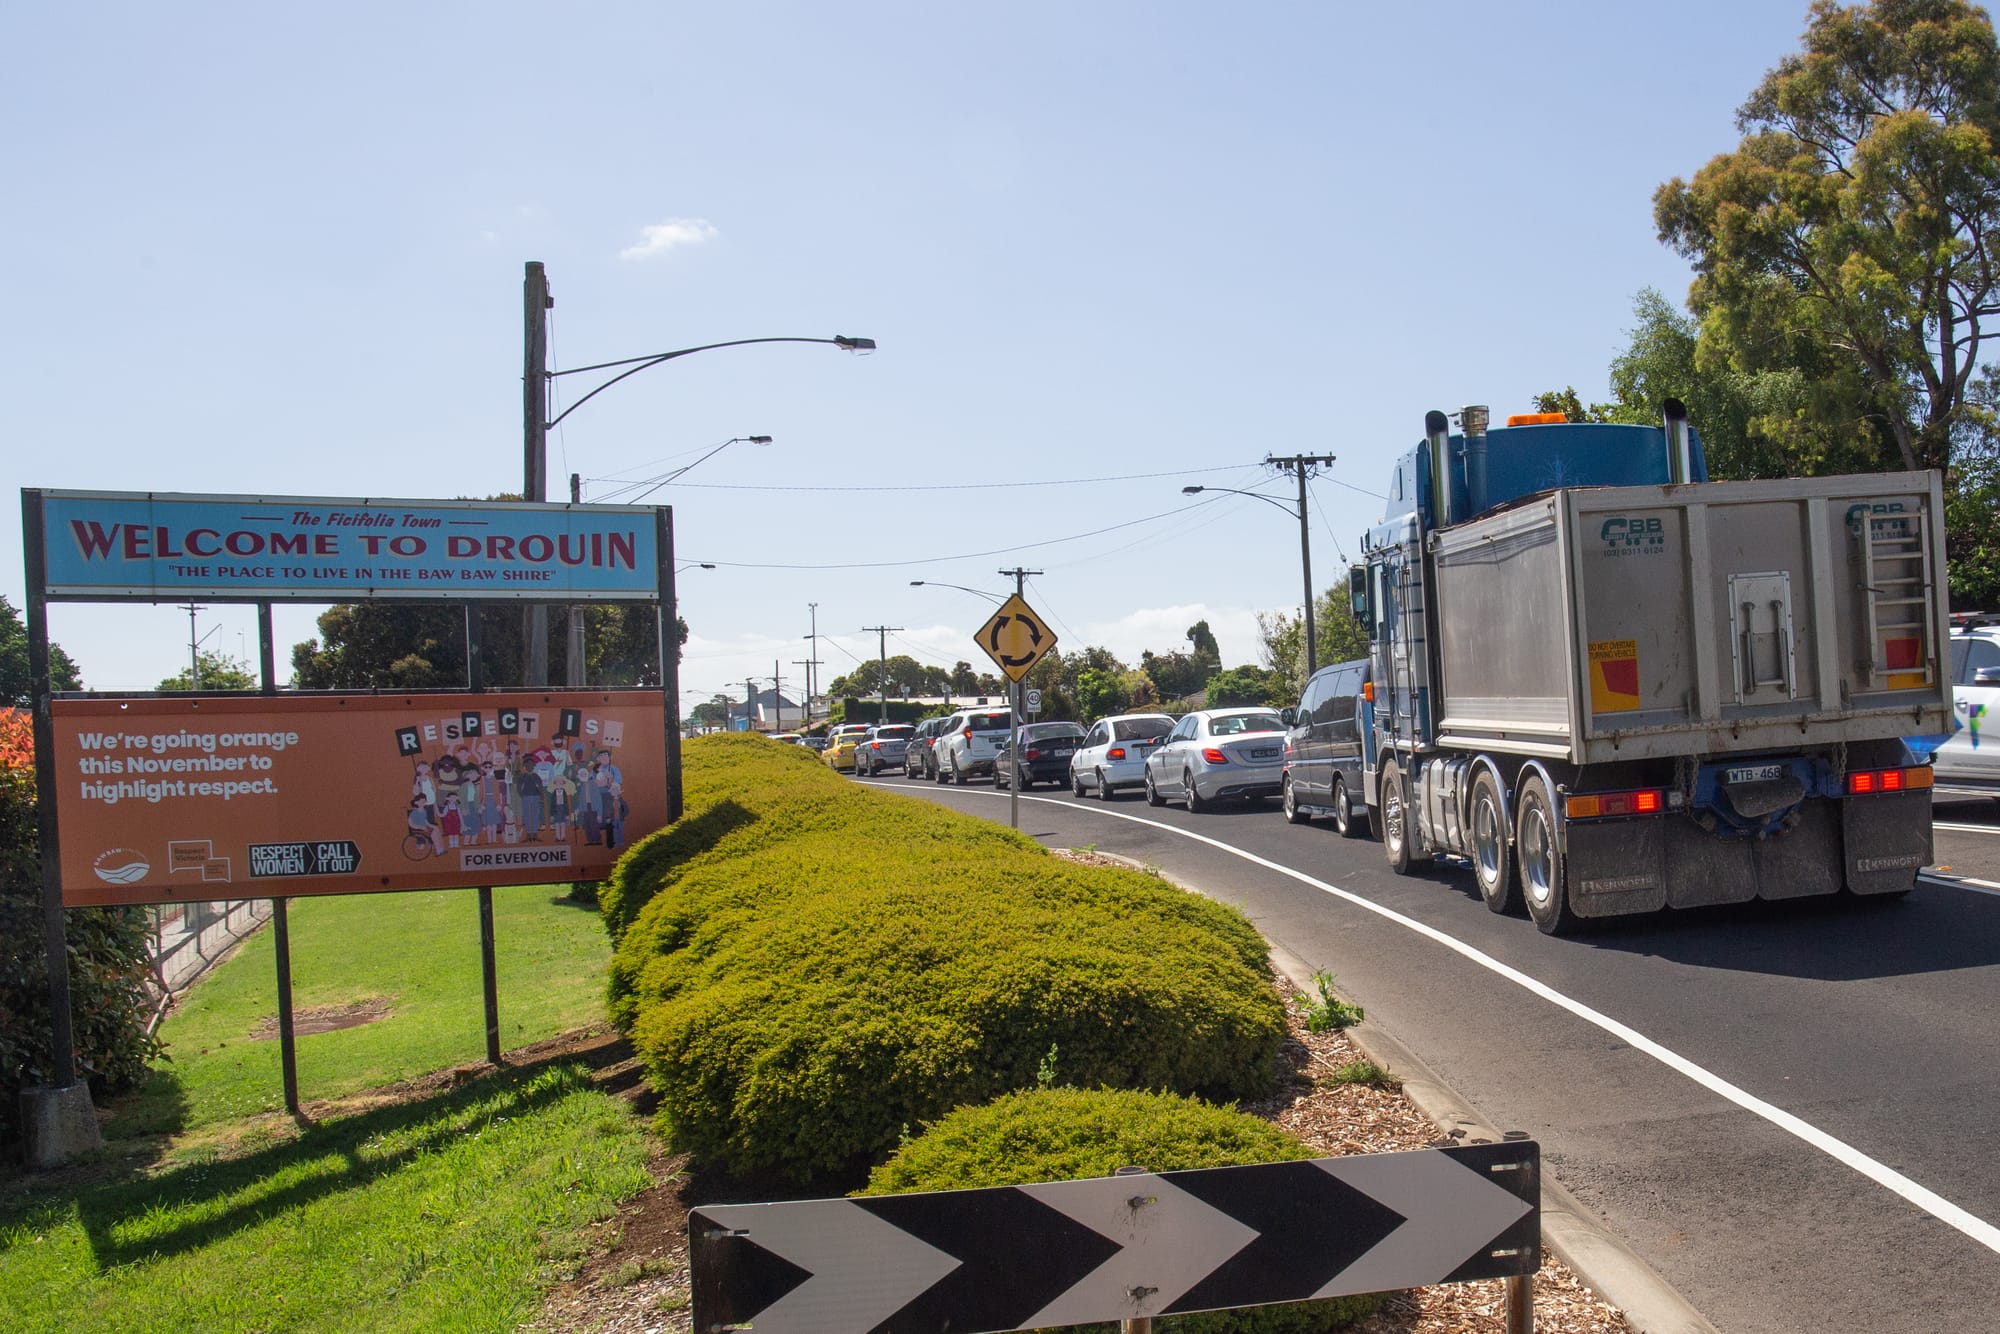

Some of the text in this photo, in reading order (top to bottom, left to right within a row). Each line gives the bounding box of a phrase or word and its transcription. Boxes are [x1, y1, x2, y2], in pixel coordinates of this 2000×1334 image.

[292, 511, 441, 528] The Ficifolia Town
[70, 519, 636, 570] WELCOME TO DROUIN
[217, 566, 275, 579] PLACE
[280, 567, 306, 579] TO
[313, 567, 348, 580] LIVE
[355, 568, 373, 580] IN
[379, 568, 412, 580] THE
[418, 569, 455, 581] BAW
[461, 569, 498, 581] BAW
[1589, 640, 1636, 652] DO NOT OVERTAKE
[1589, 648, 1636, 660] TURNING VEHICLE
[401, 713, 537, 750] RESPECT
[78, 729, 299, 754] We’re going orange
[79, 752, 273, 775] this November to
[80, 777, 279, 805] highlight respect.
[251, 844, 306, 860] RESPECT
[317, 843, 353, 860] CALL
[464, 850, 568, 866] FOR EVERYONE
[252, 859, 305, 875] WOMEN
[318, 859, 353, 873] IT OUT
[1871, 856, 1923, 868] KENWORTH
[1595, 876, 1653, 890] KENWORTH
